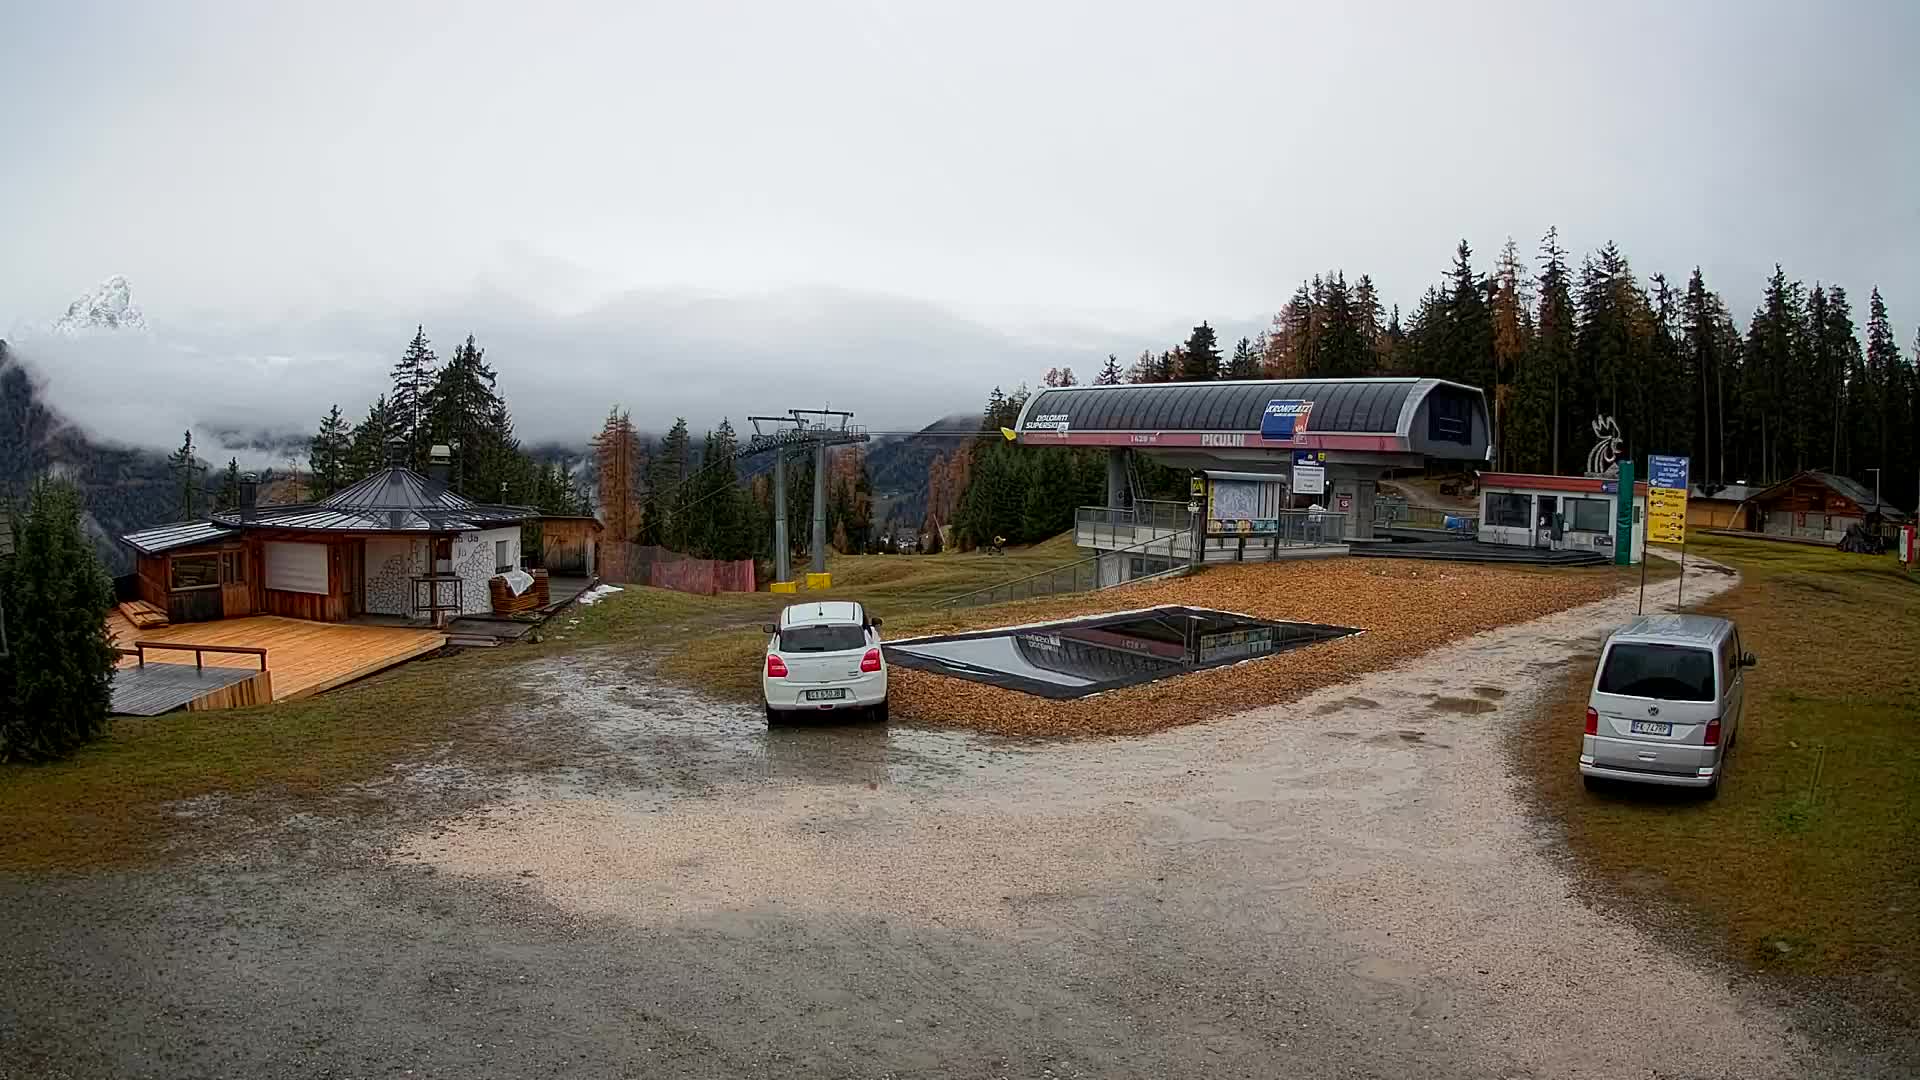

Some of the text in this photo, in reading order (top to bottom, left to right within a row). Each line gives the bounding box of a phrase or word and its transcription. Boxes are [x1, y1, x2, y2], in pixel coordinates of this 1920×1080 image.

[1265, 404, 1312, 413] KRONPLATZ
[1025, 421, 1058, 429] SUPERSKI
[1201, 433, 1245, 447] PICULIN
